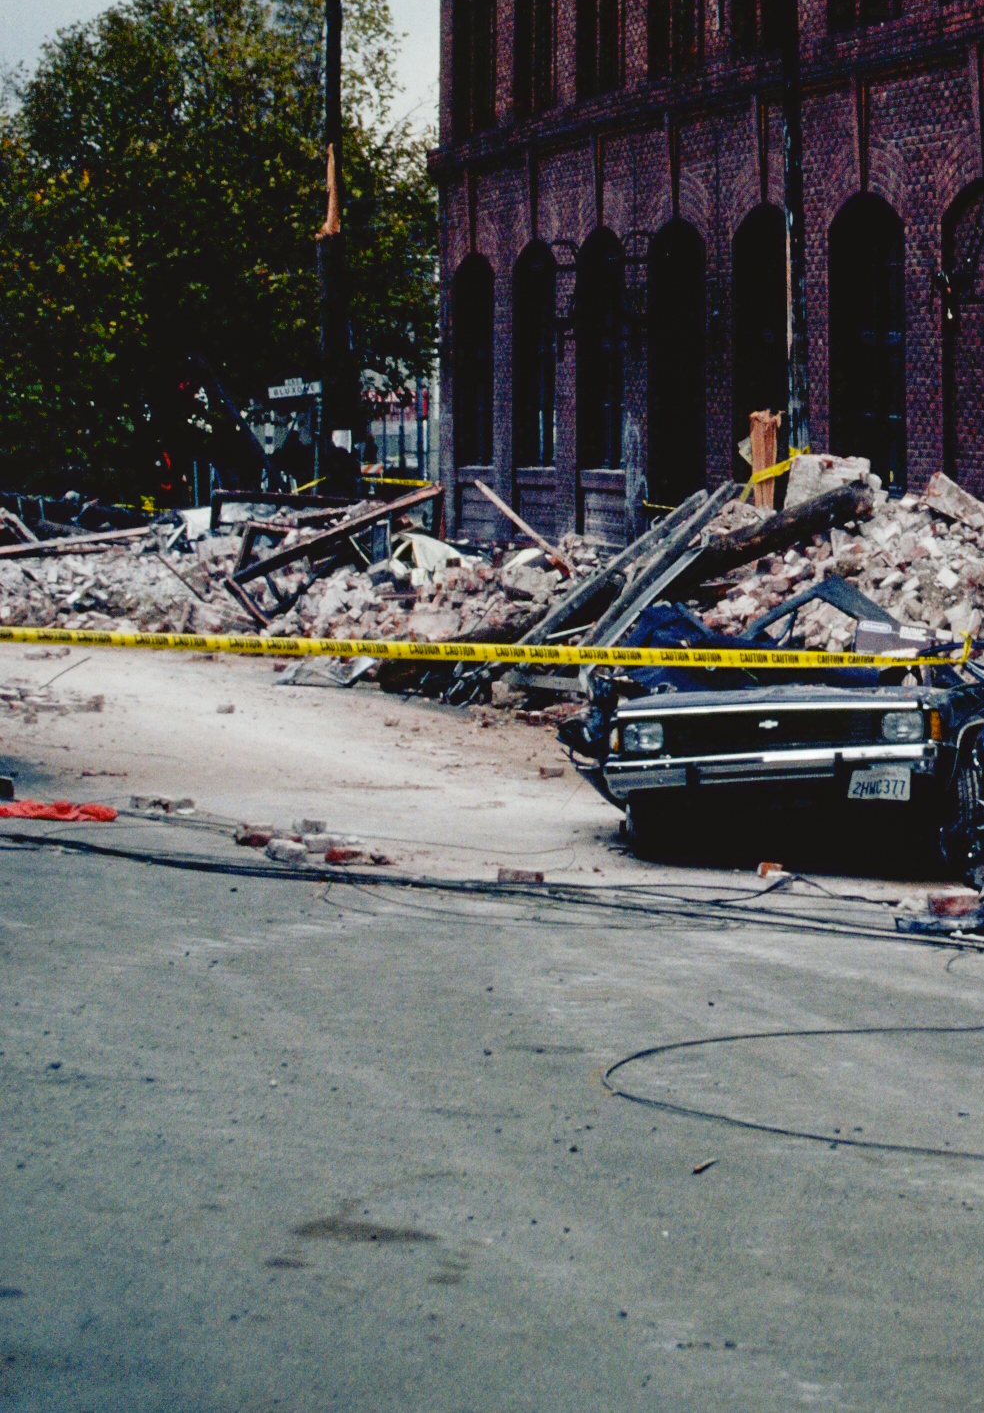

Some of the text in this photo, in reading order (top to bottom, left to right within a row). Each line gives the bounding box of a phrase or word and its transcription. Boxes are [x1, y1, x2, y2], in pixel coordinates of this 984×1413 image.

[320, 641, 352, 652] CAUTION
[357, 643, 389, 654] CAUTION
[408, 645, 440, 655] CAUTION
[444, 646, 476, 657] CAUTION
[494, 647, 526, 658] CAUTION
[529, 649, 560, 659] CAUTION
[579, 650, 609, 660] CAUTION
[612, 651, 642, 661] CAUTION
[660, 651, 690, 662] CAUTION
[693, 652, 722, 663] CAUTION
[740, 653, 768, 664] CAUTION
[771, 654, 799, 665] CAUTION
[816, 655, 845, 665] CAUTION
